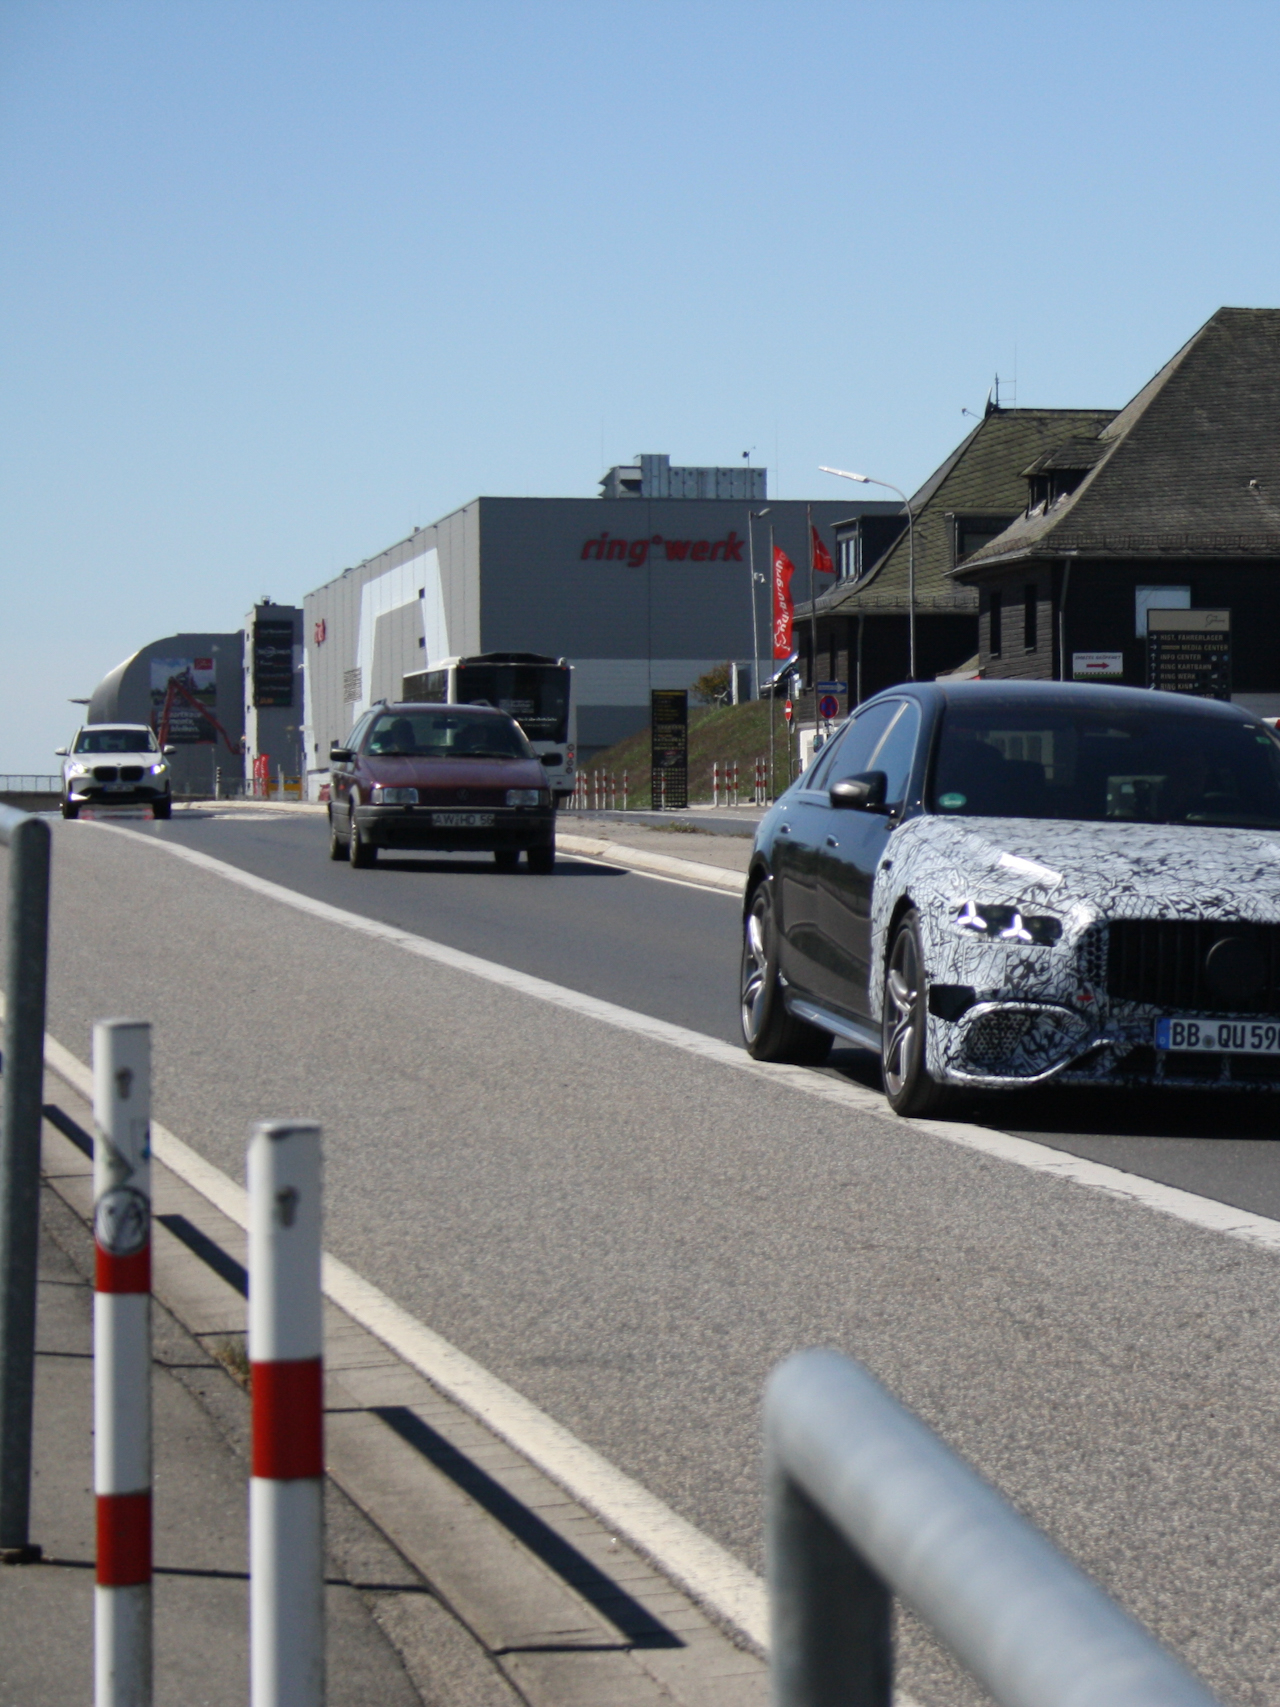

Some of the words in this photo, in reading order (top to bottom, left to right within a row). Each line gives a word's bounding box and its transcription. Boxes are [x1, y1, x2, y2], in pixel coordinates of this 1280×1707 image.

[434, 815, 454, 824] AW
[1172, 1022, 1200, 1046] BB
[1218, 1024, 1246, 1048] QU
